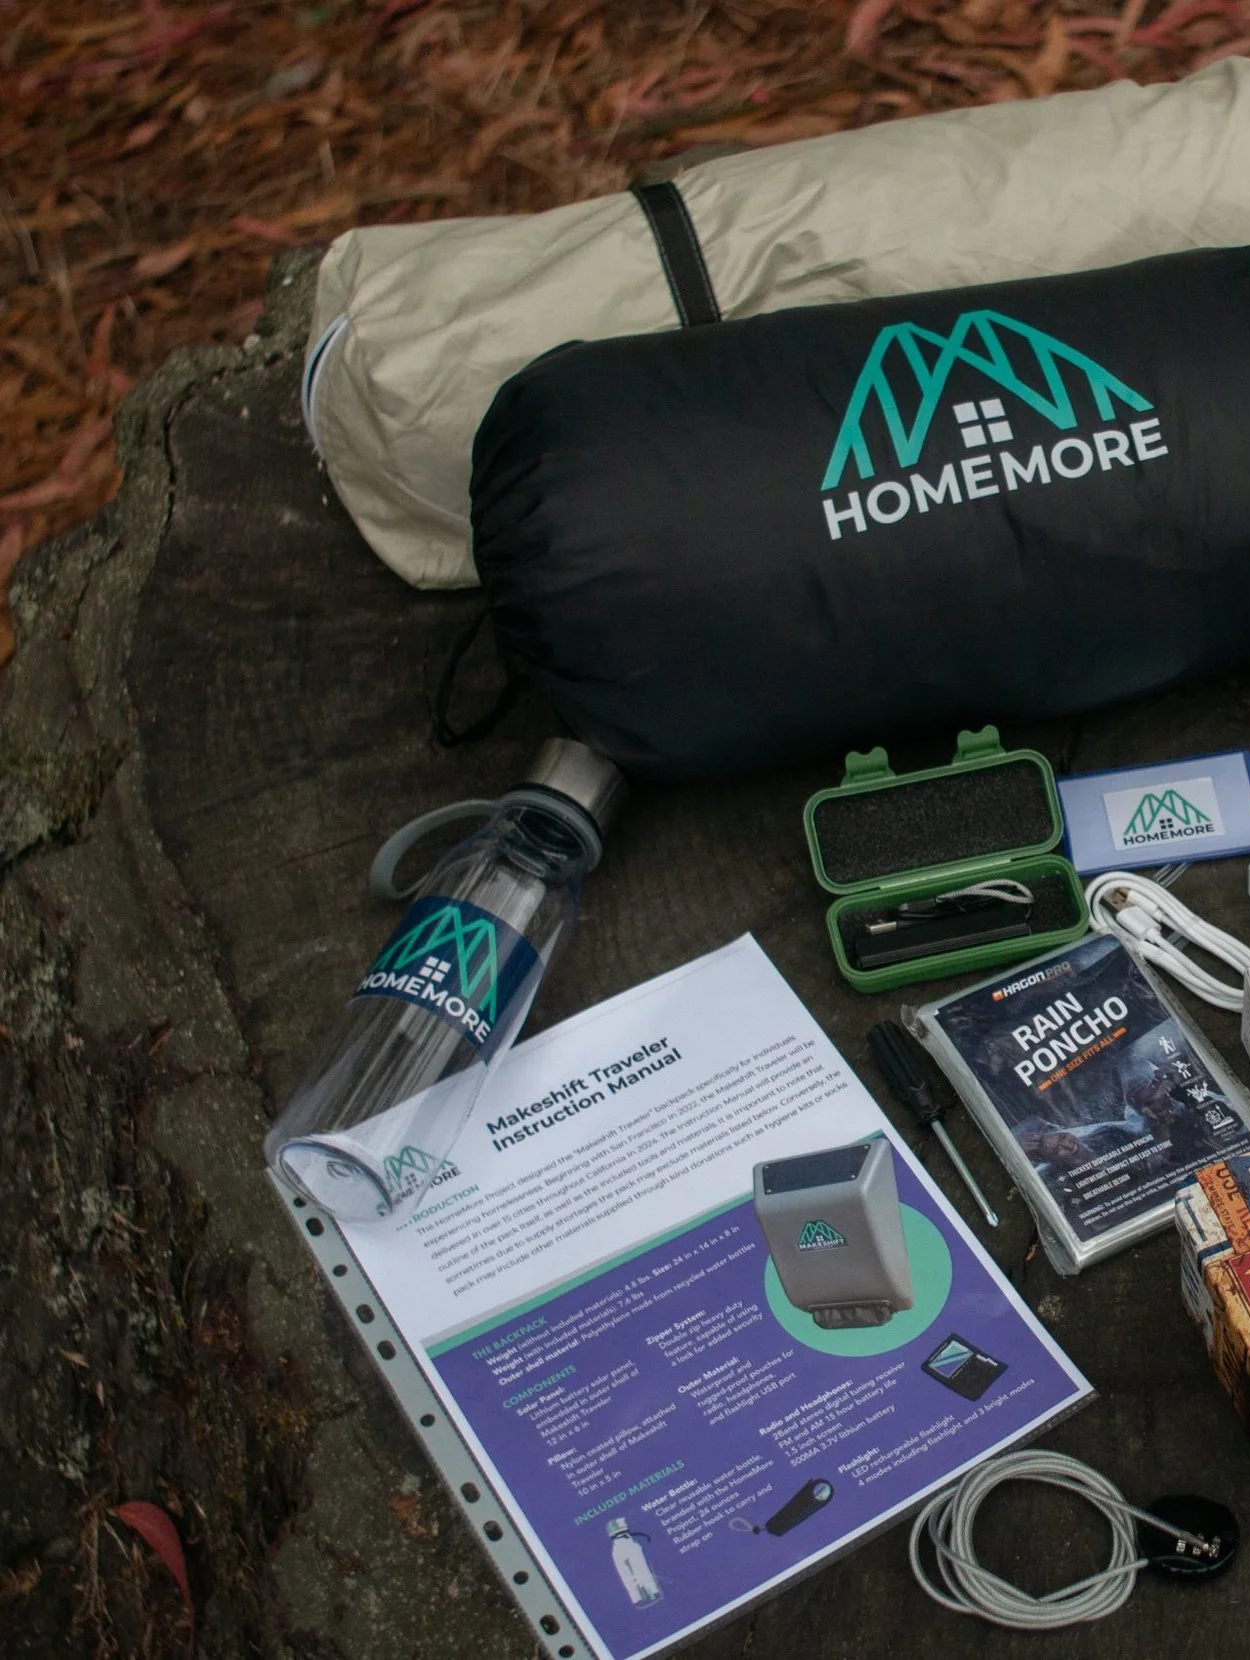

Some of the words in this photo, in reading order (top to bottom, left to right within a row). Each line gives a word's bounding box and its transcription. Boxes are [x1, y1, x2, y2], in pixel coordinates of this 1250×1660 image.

[822, 418, 1169, 540] HOMEMORE
[1124, 823, 1215, 845] HOMEMORE
[359, 972, 491, 1044] HOMEMORE
[1012, 992, 1084, 1051] RAIN
[1013, 996, 1129, 1086] PONCHO
[1050, 1067, 1068, 1082] ONE
[1066, 1055, 1084, 1071] SIZE
[1082, 1044, 1101, 1059] FITS
[1100, 1034, 1114, 1047] ALL
[485, 1076, 589, 1135] Makeshift
[587, 1034, 671, 1084] Traveler
[491, 1087, 606, 1152] Instruction
[605, 1047, 682, 1094] Manual
[393, 1183, 480, 1232] RODUCTION
[471, 1344, 492, 1360] THE
[491, 1315, 548, 1350] BACKPACK
[645, 1326, 674, 1346] Zipper
[673, 1308, 707, 1331] System:
[501, 1363, 577, 1409] COMPONENTS
[677, 1375, 703, 1394] Outer
[702, 1355, 740, 1380] Material:
[758, 1417, 783, 1435] Radio
[782, 1407, 800, 1421] and
[799, 1377, 855, 1413] Headphones:
[837, 1444, 882, 1475] Flashlight:
[850, 1463, 870, 1478] LED
[868, 1433, 921, 1469] rechargeable
[918, 1413, 956, 1440] flashlight
[573, 1490, 628, 1525] INCLUDED
[627, 1458, 685, 1495] MATERIALS
[640, 1492, 668, 1512] Water
[668, 1476, 698, 1497] Bottle:
